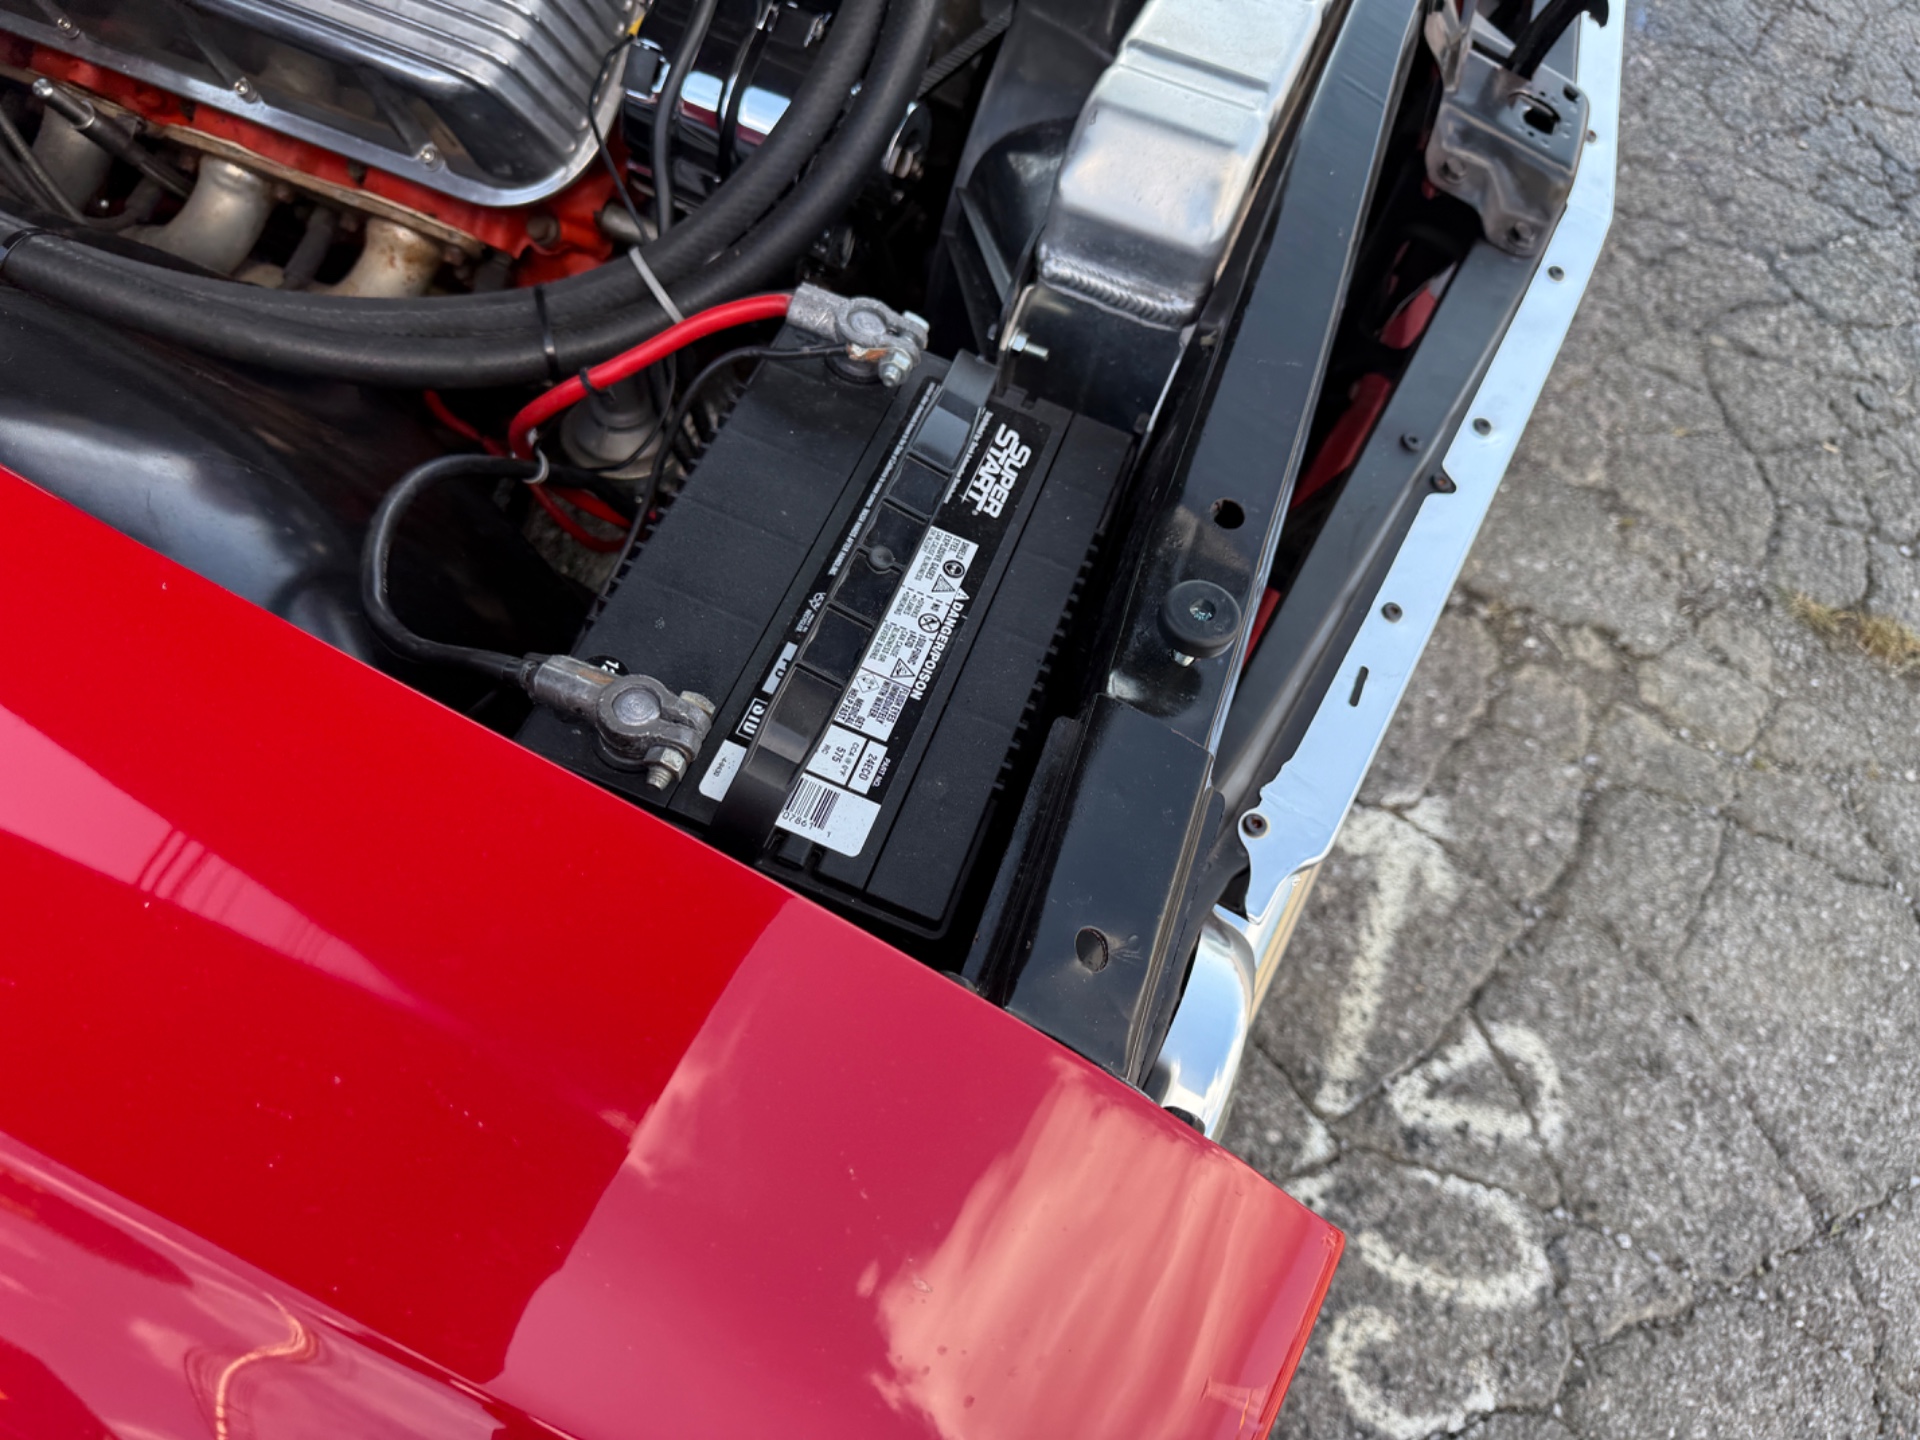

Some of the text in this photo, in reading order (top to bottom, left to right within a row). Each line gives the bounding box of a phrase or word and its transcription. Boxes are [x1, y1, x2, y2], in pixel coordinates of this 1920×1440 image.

[967, 422, 1020, 513] START
[982, 442, 1032, 518] SUPER
[924, 533, 953, 580] EXPLOSIVE GASES
[955, 541, 970, 560] SHIELD
[904, 633, 917, 648] ACID
[906, 636, 927, 666] SULFURIC
[909, 599, 964, 701] DANGER/POISON
[835, 686, 858, 722] HELP FAST.
[844, 696, 864, 726] MEDICAL
[866, 679, 891, 720] WITH WATER.
[874, 684, 901, 724] IMMEDIATELY
[885, 687, 909, 723] FLUSH EYES
[853, 714, 866, 729] GET
[830, 745, 846, 763] 575
[847, 741, 860, 757] CCA
[877, 756, 891, 775] PART
